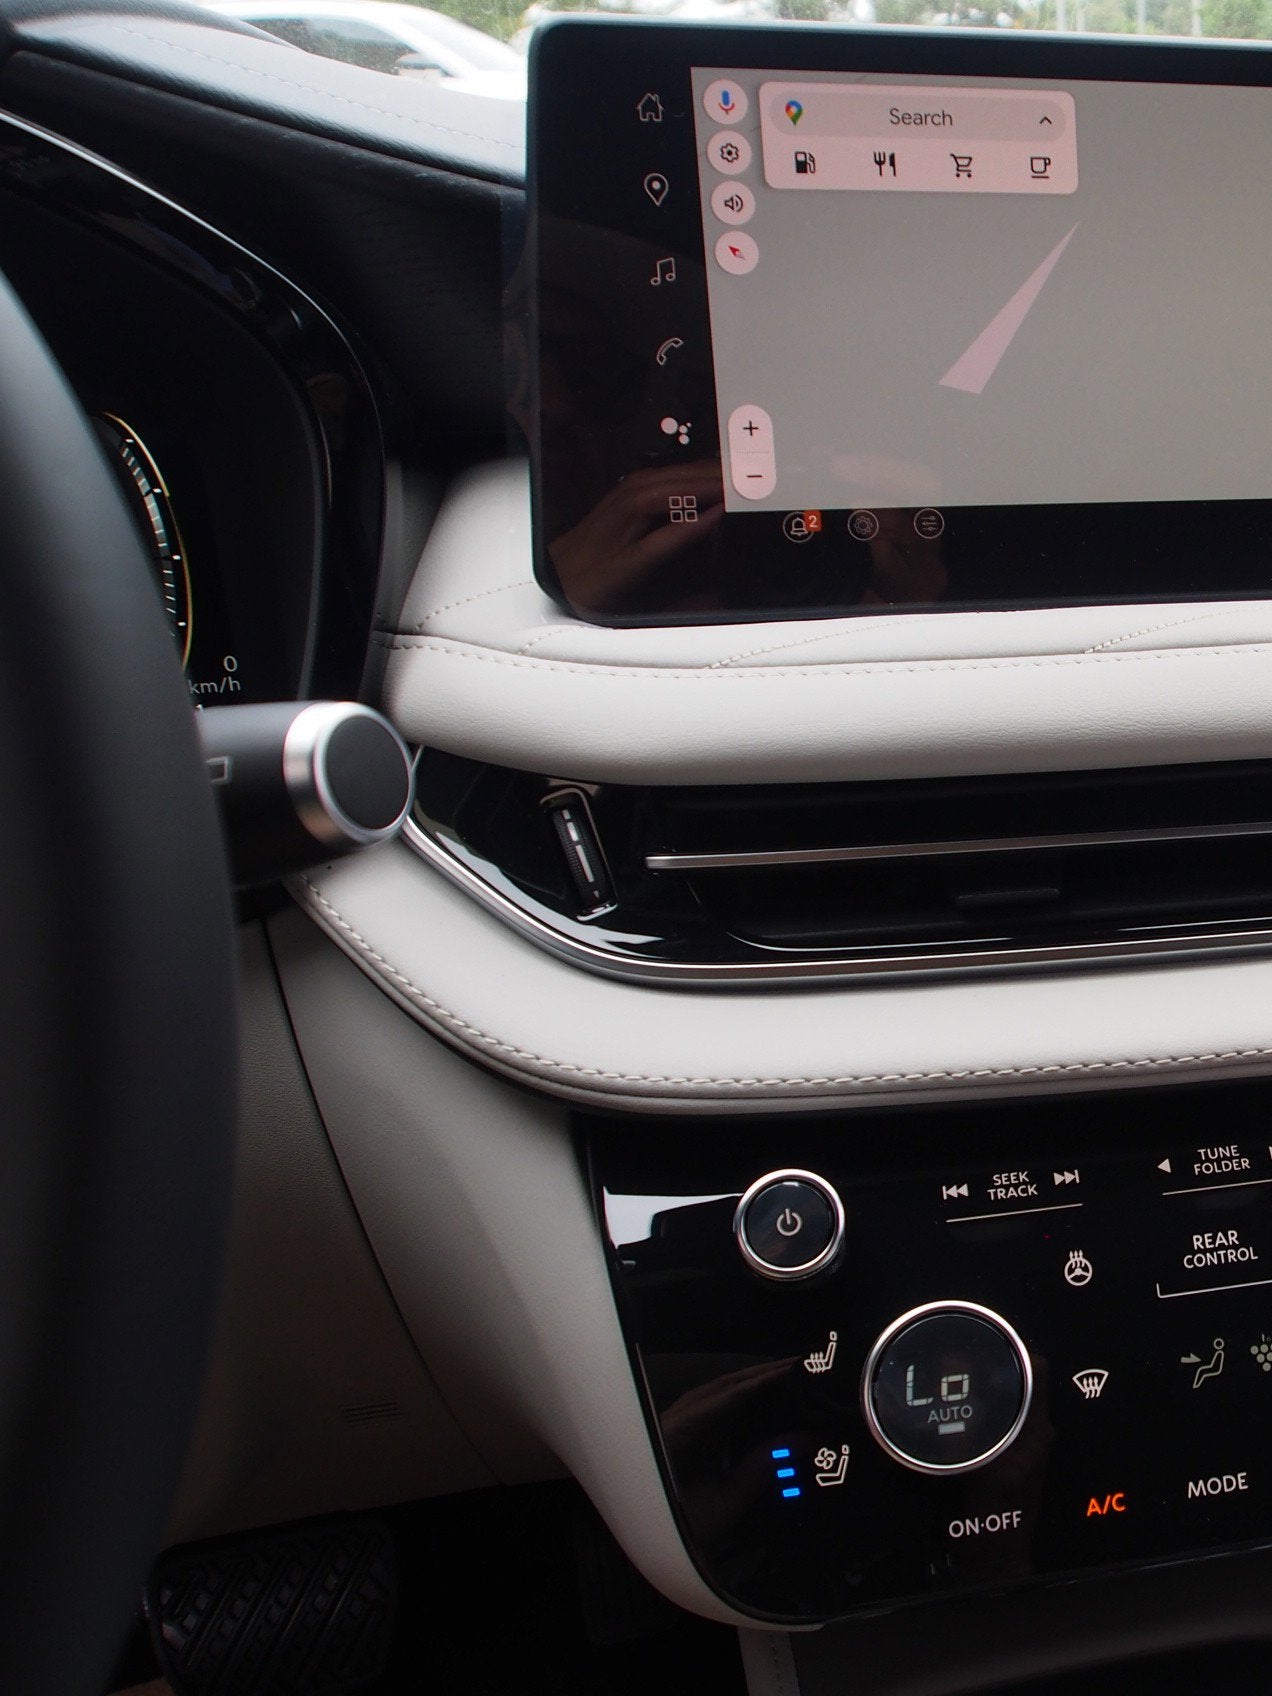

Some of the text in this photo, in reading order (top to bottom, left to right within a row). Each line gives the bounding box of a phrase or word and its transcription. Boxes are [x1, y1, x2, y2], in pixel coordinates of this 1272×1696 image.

[888, 108, 954, 127] Search
[808, 514, 818, 528] 2
[223, 655, 238, 672] 0
[187, 676, 241, 694] km/h
[1197, 1145, 1240, 1162] TUNE
[1193, 1157, 1251, 1176] FOLDER
[992, 1171, 1030, 1187] SEEK
[986, 1183, 1039, 1201] TRACK
[1192, 1229, 1240, 1251] REAR
[1183, 1246, 1259, 1269] CONTROL
[906, 1364, 970, 1407] Lo
[927, 1404, 973, 1424] AUTO
[1187, 1472, 1249, 1499] MODE
[1086, 1492, 1126, 1517] A/C
